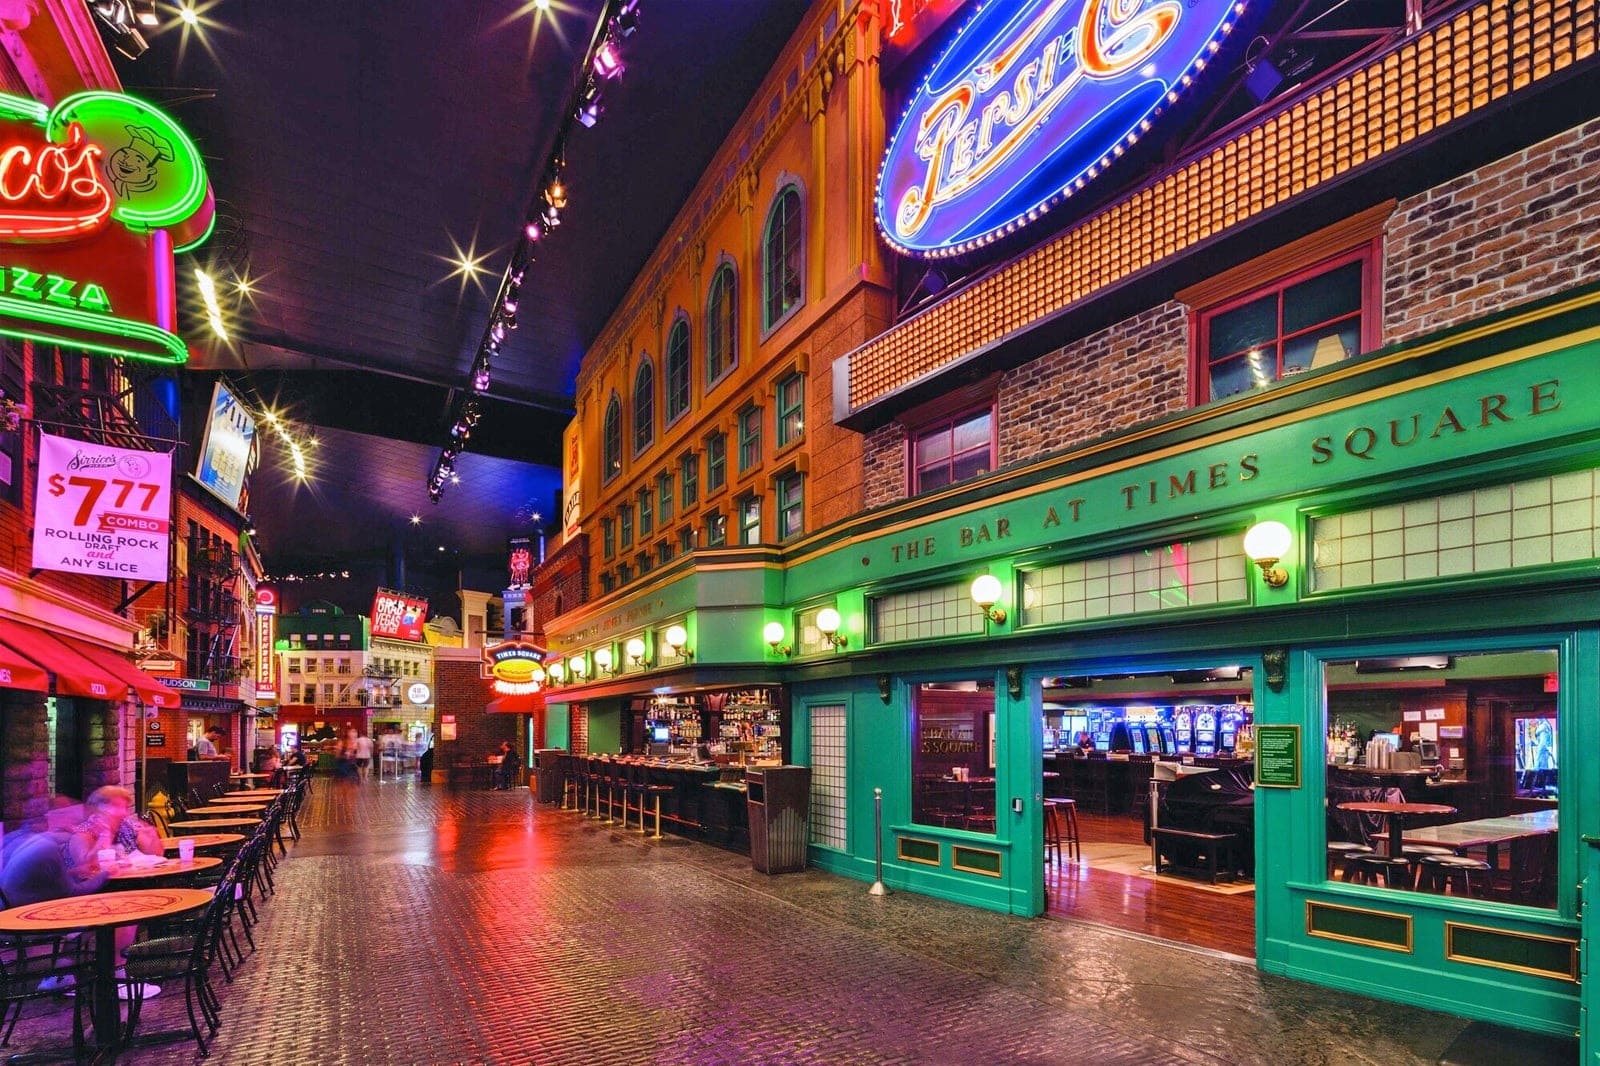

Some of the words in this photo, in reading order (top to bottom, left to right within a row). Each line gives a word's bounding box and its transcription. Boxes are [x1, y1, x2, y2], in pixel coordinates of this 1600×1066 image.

[891, 535, 936, 564] THE
[959, 518, 1011, 548] BAR
[1042, 498, 1085, 528] AT
[1121, 453, 1260, 510] TIMES
[1311, 379, 1563, 465] SQUARE
[106, 516, 159, 530] COMBO
[45, 527, 112, 544] ROLLING
[117, 536, 160, 550] ROCK
[85, 542, 120, 551] DRAFT
[87, 550, 115, 560] and
[60, 557, 93, 568] ANY
[97, 560, 138, 573] SLICE
[377, 596, 405, 616] GRAB
[375, 611, 401, 628] VEGAS
[496, 650, 517, 660] TIMES
[518, 650, 542, 660] SQUARE
[158, 678, 196, 688] HUDSON
